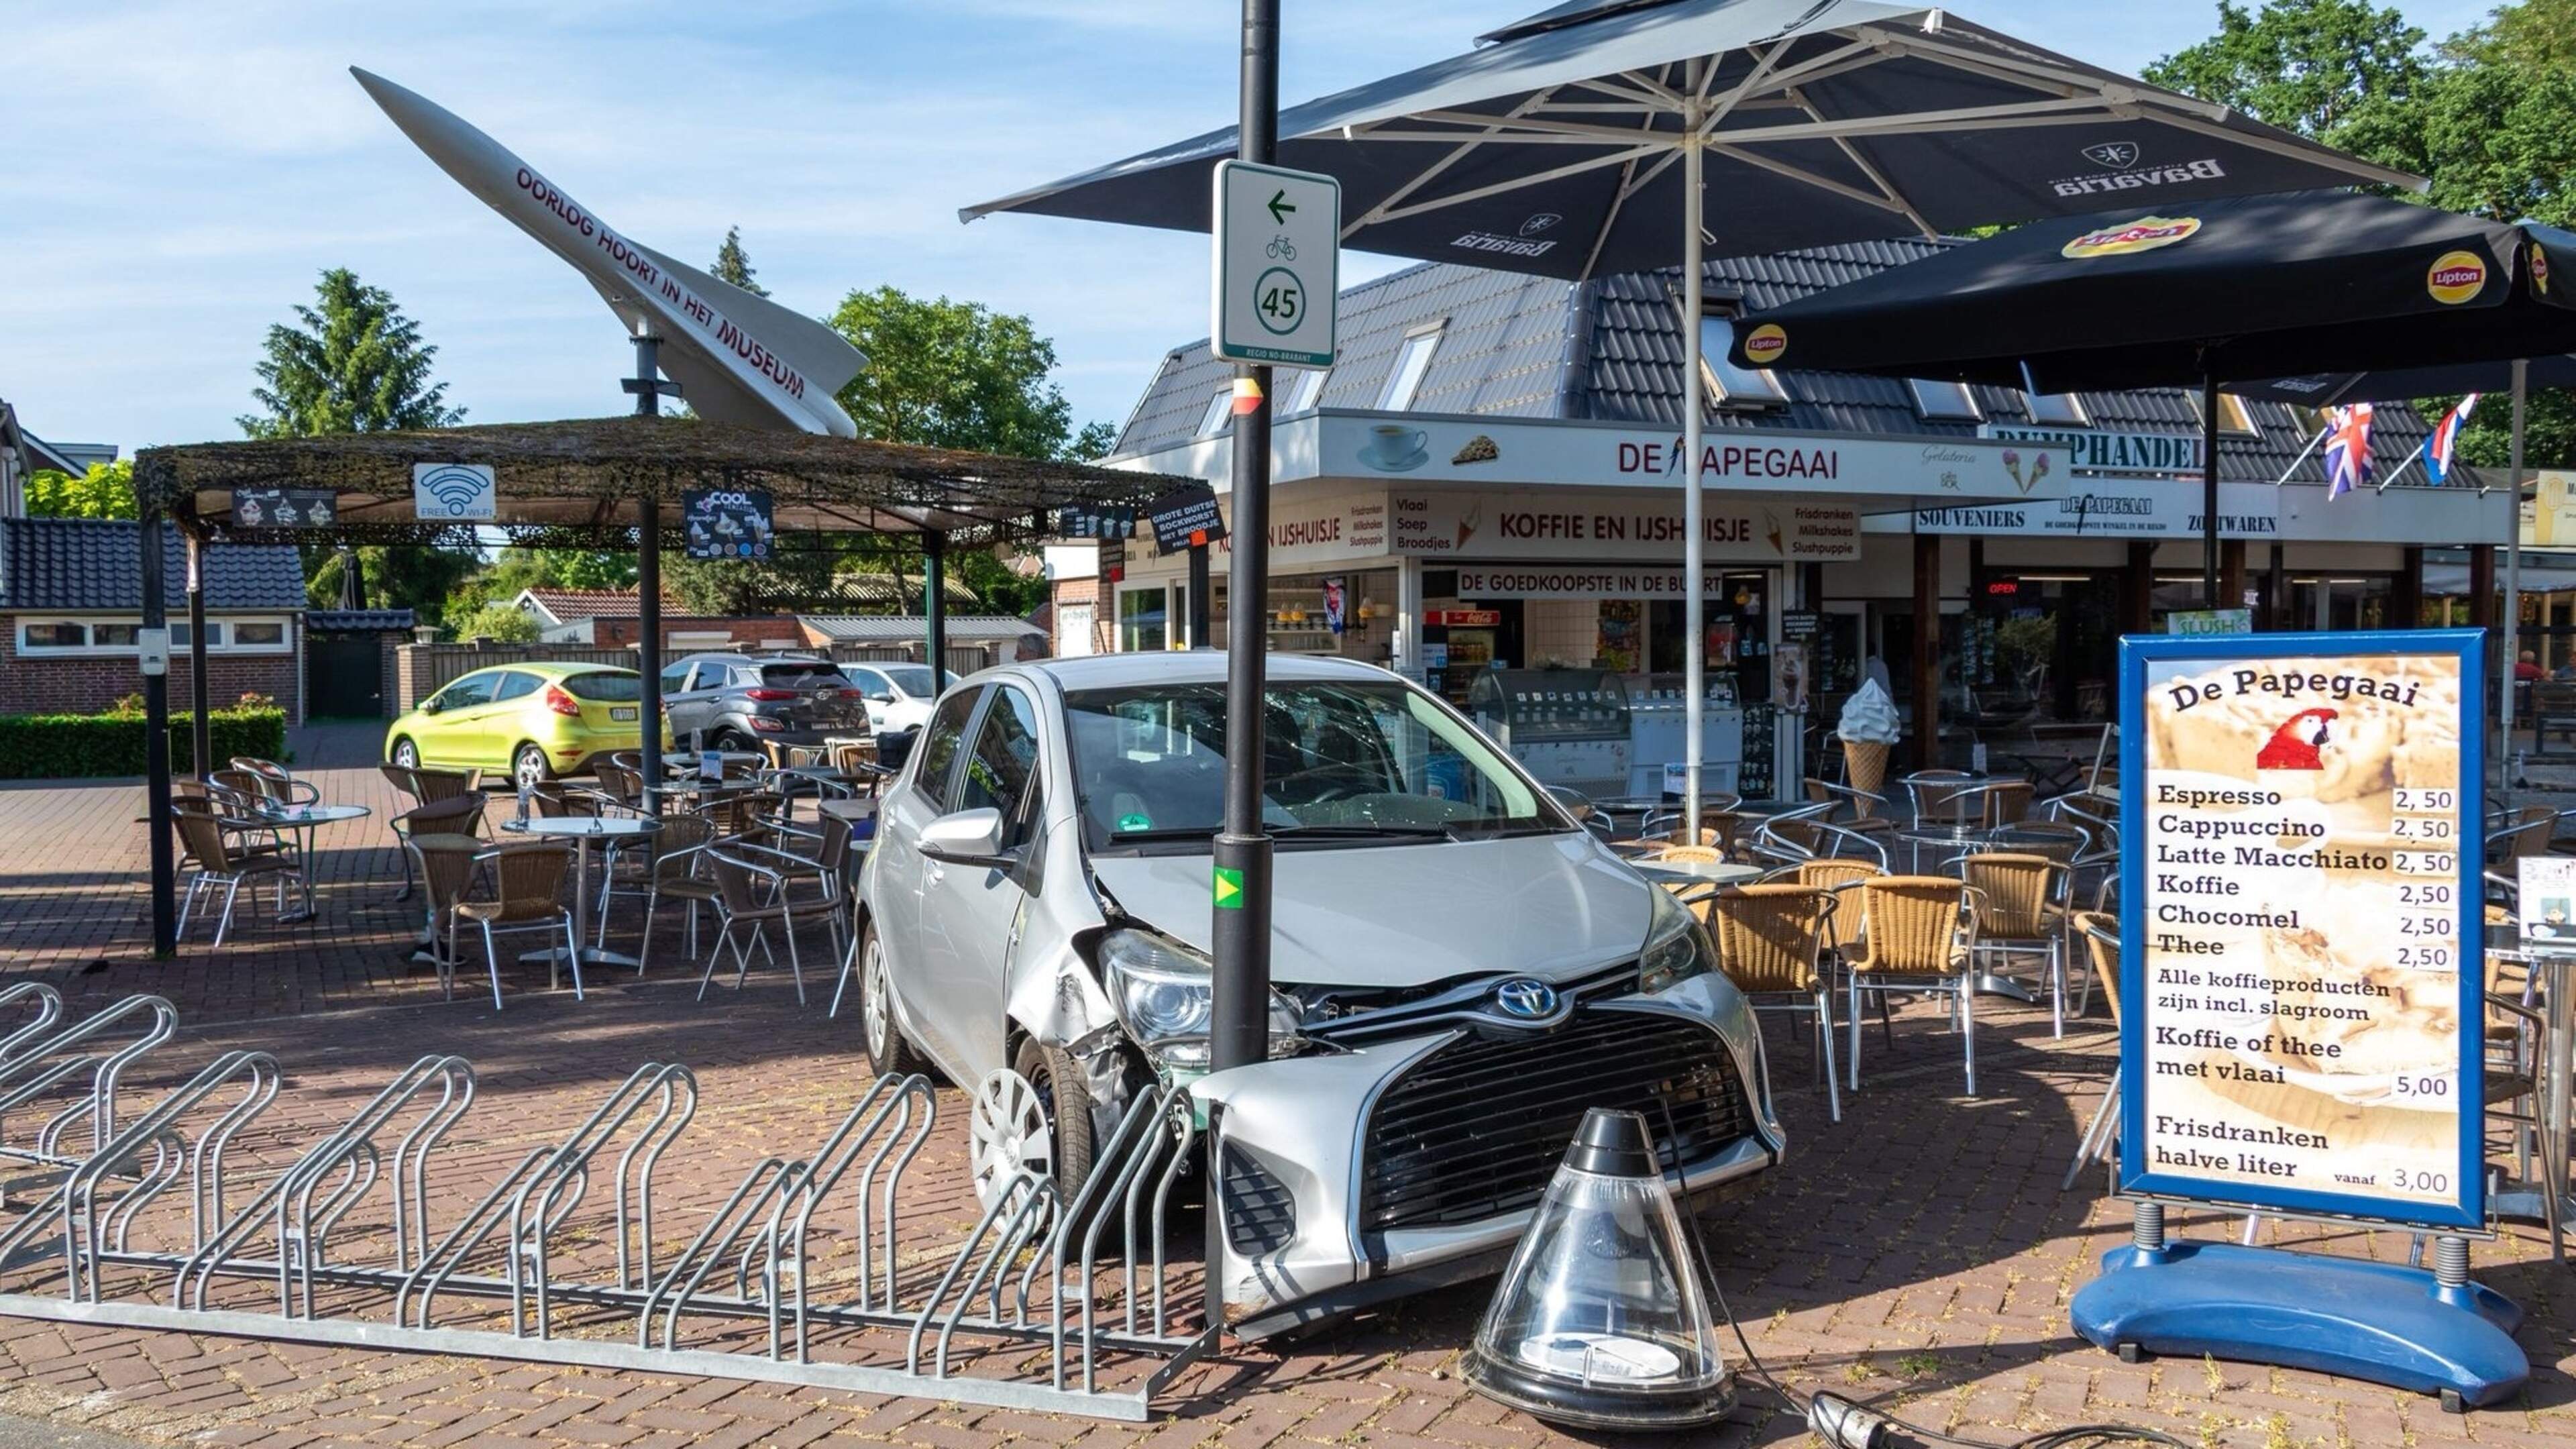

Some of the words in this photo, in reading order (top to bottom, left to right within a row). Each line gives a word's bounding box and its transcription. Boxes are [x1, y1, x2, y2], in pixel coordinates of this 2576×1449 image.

[517, 168, 594, 236] OORLOG
[597, 229, 659, 286] HOORT
[662, 277, 681, 304] IN
[684, 294, 716, 327] HET
[716, 319, 805, 400] MUSEUM
[2436, 271, 2478, 284] Lipton
[1262, 287, 1297, 319] 45
[1246, 348, 1267, 359] REGIO
[1269, 350, 1311, 363] NO-BRABANT
[1752, 337, 1782, 351] Lipton
[1619, 443, 1663, 473] DE
[1683, 444, 1837, 480] APEGAAI
[710, 492, 753, 505] COOL
[1397, 499, 1428, 511] Vlaai
[2061, 496, 2080, 514] DE
[2084, 497, 2153, 515] PAPEGAAI
[421, 507, 447, 517] FREE
[467, 508, 492, 518] WI-FI
[1152, 508, 1182, 524] GROTE
[1184, 499, 1217, 515] DUITSE
[1159, 510, 1216, 532] BOCKWORST
[1795, 508, 1853, 520] Frisdranken
[1918, 508, 2025, 528] SOUVENIERS
[1160, 531, 1176, 542] MET
[1177, 519, 1220, 537] BROODJE
[1279, 517, 1340, 547] IJSHUISJE
[1397, 517, 1428, 533] Soep
[1500, 513, 1584, 539] KOFFIE
[1594, 515, 1625, 540] EN
[1635, 515, 1750, 542] IJSHISJE
[1799, 525, 1853, 537] Milkshakes
[2188, 515, 2276, 532] ZOTWAREN
[1397, 537, 1450, 550] Broodjes
[1792, 541, 1853, 555] Slushpuppie
[1462, 574, 1483, 592] DE
[1489, 574, 1613, 592] GOEDKOOPSTE
[1619, 576, 1636, 592] IN
[1643, 576, 1662, 592] DE
[1989, 582, 2018, 594] OPEN
[2181, 618, 2235, 635] SLUSH
[2169, 682, 2223, 712] De
[2232, 669, 2421, 708] Papegaai
[2157, 784, 2282, 807] Espresso
[2157, 814, 2325, 839] Cappuccino
[2157, 845, 2226, 865] Latte
[2235, 847, 2388, 871] Macchiato
[2157, 874, 2240, 896] Koffie
[2400, 885, 2451, 906] 2,50
[2158, 904, 2300, 929] Chocomel
[2400, 918, 2451, 936] 2,50
[2157, 934, 2224, 955] Thee
[2398, 947, 2448, 967] 2,50
[2158, 969, 2201, 986] Alle
[2208, 971, 2390, 998] koffieproducten
[2158, 994, 2199, 1012] zijn
[2205, 997, 2254, 1014] incl.
[2260, 1000, 2370, 1021] slagroom
[2155, 1026, 2239, 1050] Koffie
[2247, 1034, 2275, 1052] of
[2280, 1037, 2343, 1058] thee
[2155, 1060, 2209, 1078] met
[2216, 1062, 2286, 1084] vlaai
[2397, 1076, 2448, 1097] 5,00
[2155, 1116, 2330, 1149] Frisdranken
[2155, 1146, 2229, 1171] halve
[2238, 1154, 2298, 1178] liter
[2334, 1173, 2376, 1186] vanaf
[2394, 1169, 2448, 1193] 3,00
